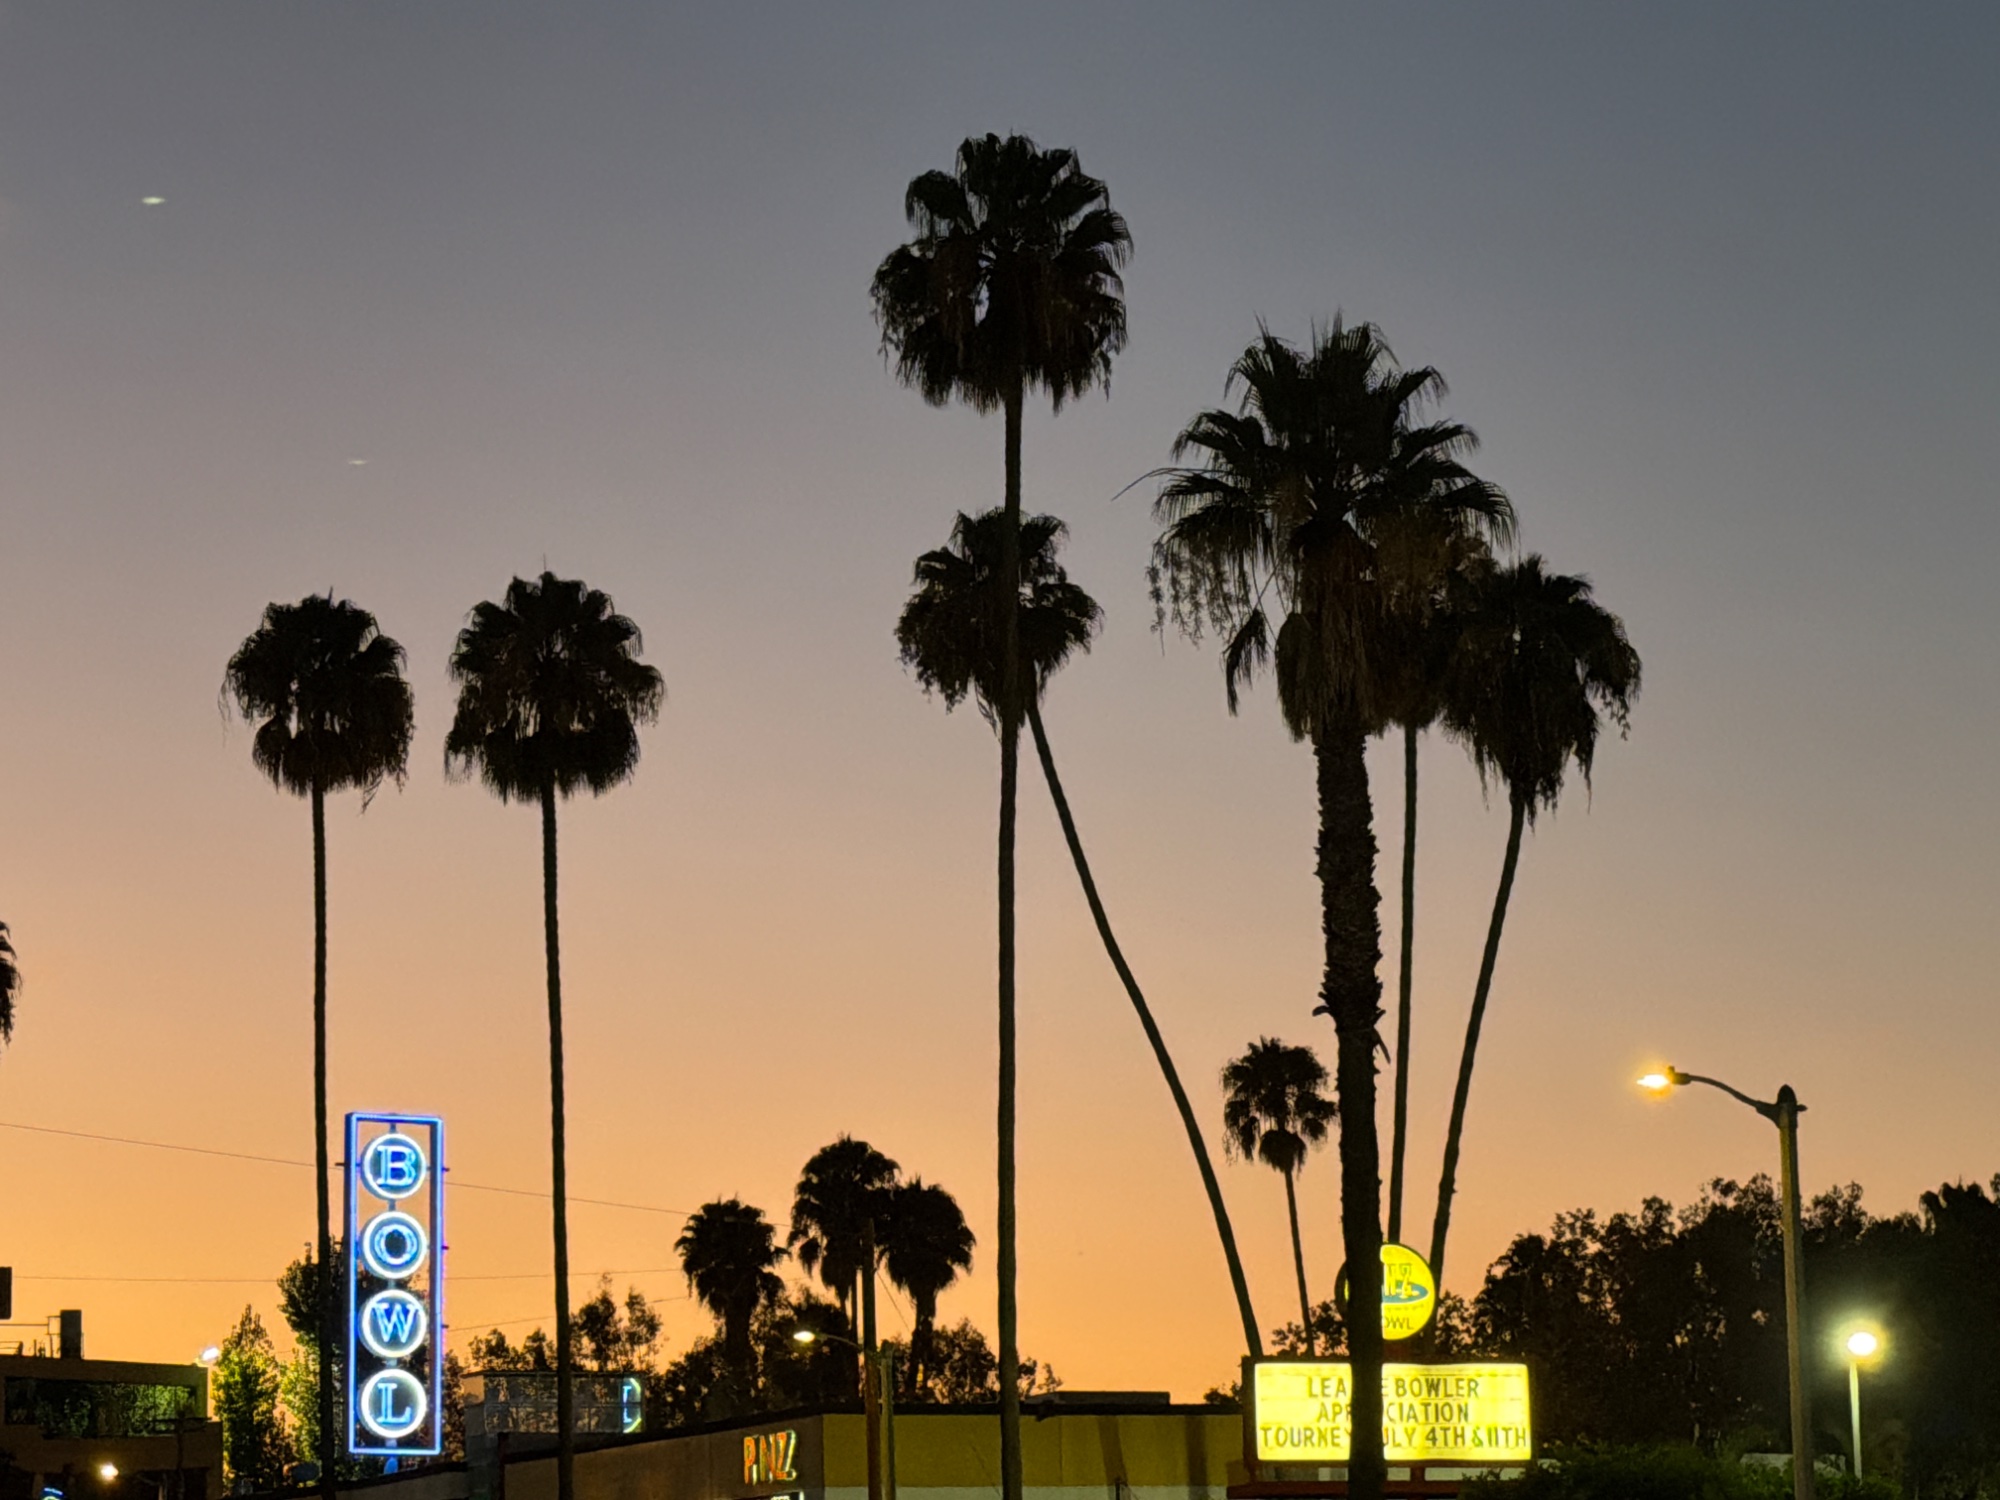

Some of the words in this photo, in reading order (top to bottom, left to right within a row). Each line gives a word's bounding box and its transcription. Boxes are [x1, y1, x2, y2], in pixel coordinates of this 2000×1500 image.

[373, 1145, 421, 1425] BOWL
[1384, 1312, 1415, 1330] OWL
[1308, 1377, 1389, 1398] LEAE
[1395, 1377, 1479, 1398] BOWLER
[1317, 1402, 1469, 1424] APCIATION
[1383, 1427, 1416, 1448] ULY
[1425, 1426, 1466, 1447] 4TH
